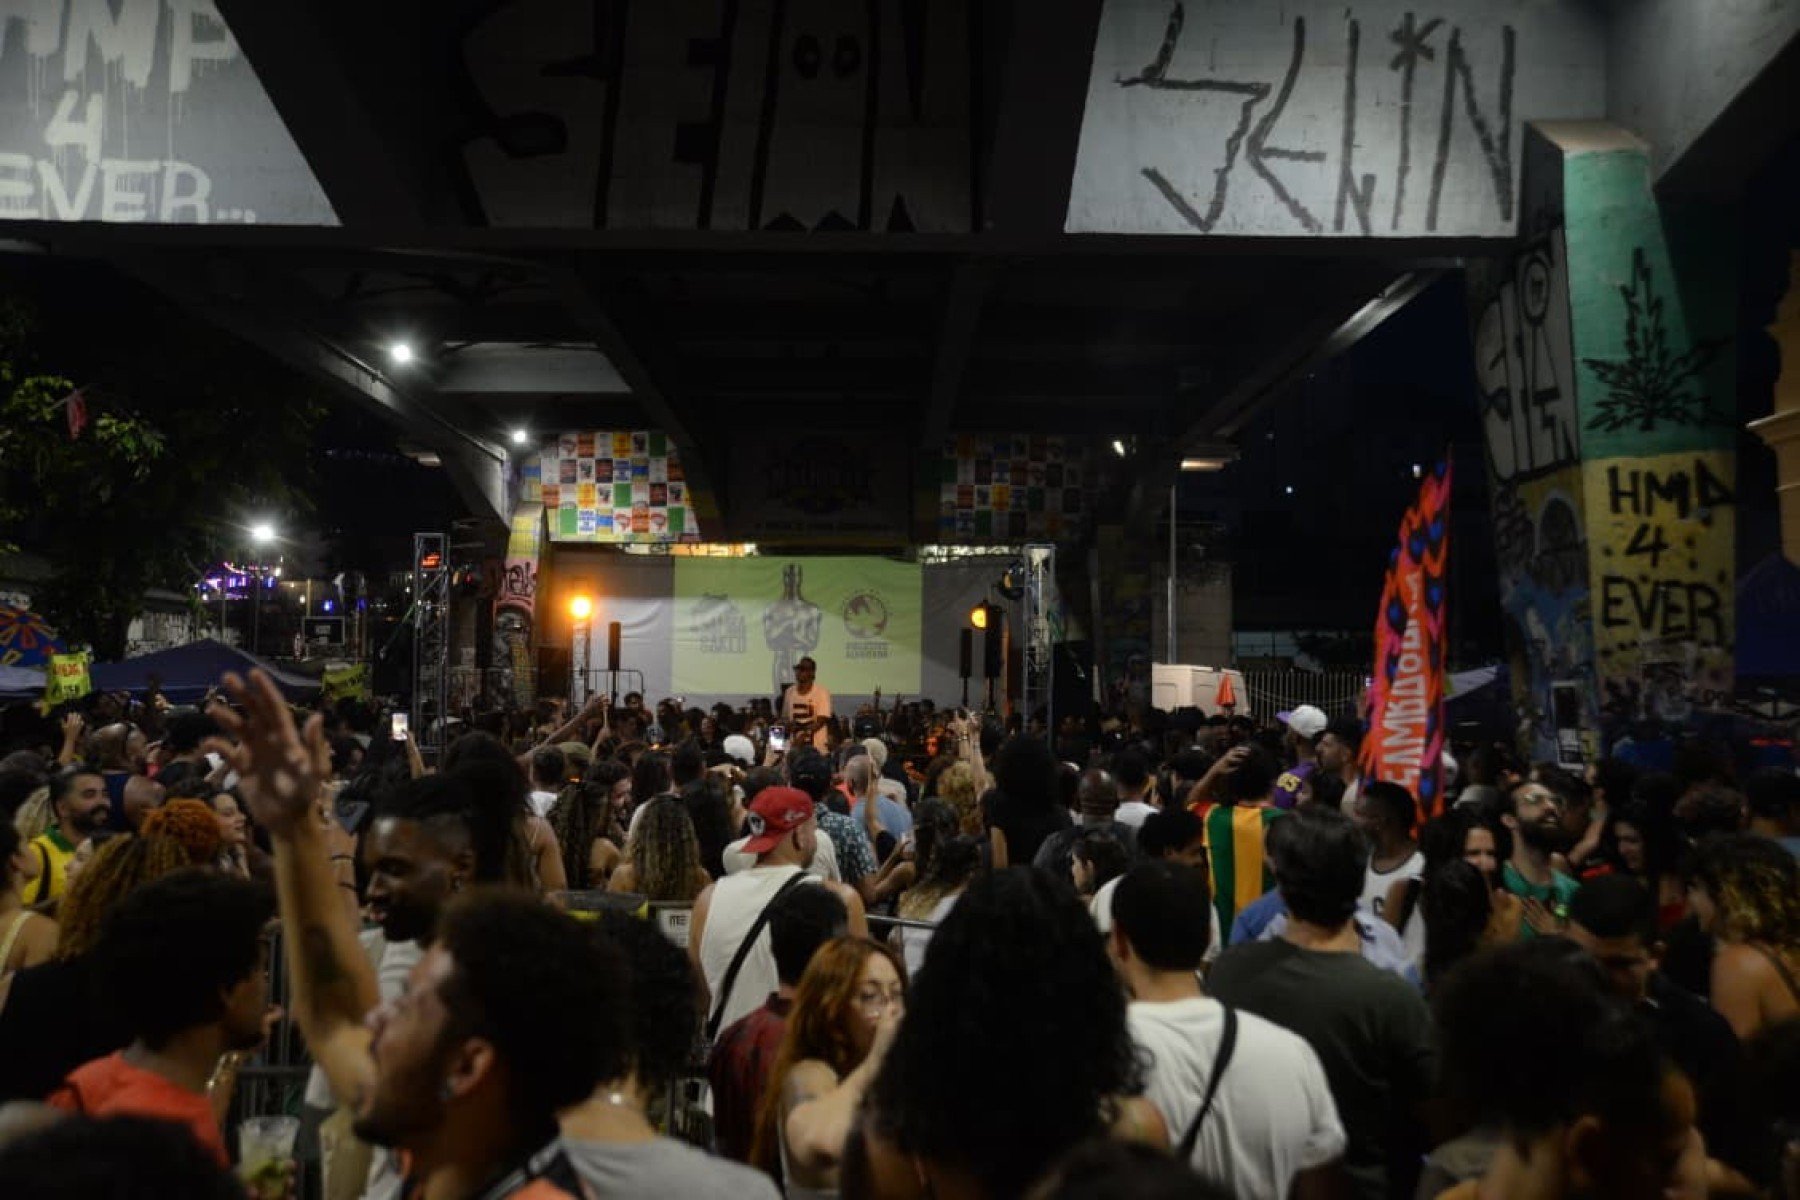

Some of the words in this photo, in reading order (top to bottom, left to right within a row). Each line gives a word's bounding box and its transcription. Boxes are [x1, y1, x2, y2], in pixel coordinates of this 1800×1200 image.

[45, 89, 102, 165] 4
[1625, 522, 1669, 568] 4
[1601, 574, 1723, 647] EVER
